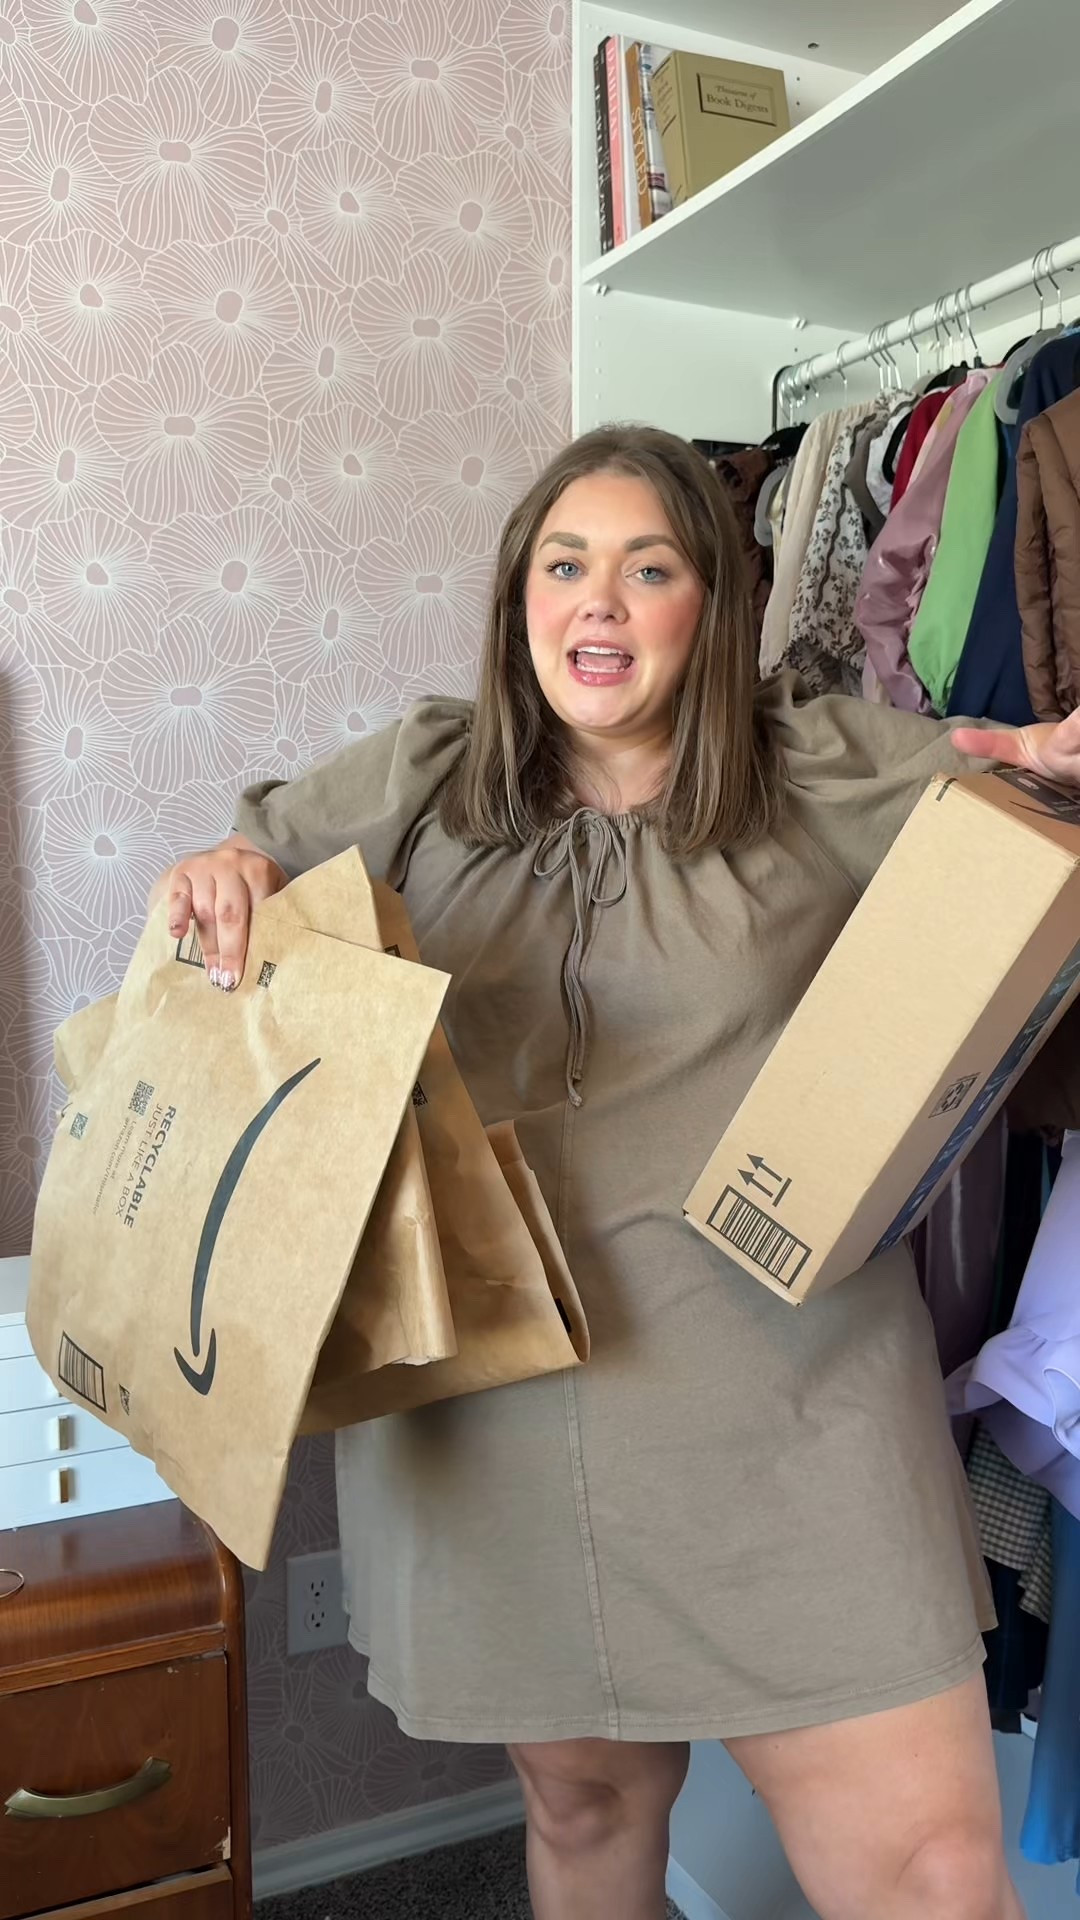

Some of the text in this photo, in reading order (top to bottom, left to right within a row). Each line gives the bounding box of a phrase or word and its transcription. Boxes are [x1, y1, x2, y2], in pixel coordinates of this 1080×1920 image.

[706, 94, 731, 106] Book
[631, 106, 648, 195] STYLED
[114, 1146, 127, 1170] more
[115, 1103, 163, 1217] JUST LIKE A BOX
[125, 1120, 137, 1146] Learn
[123, 1105, 177, 1229] RECYCLABLE
